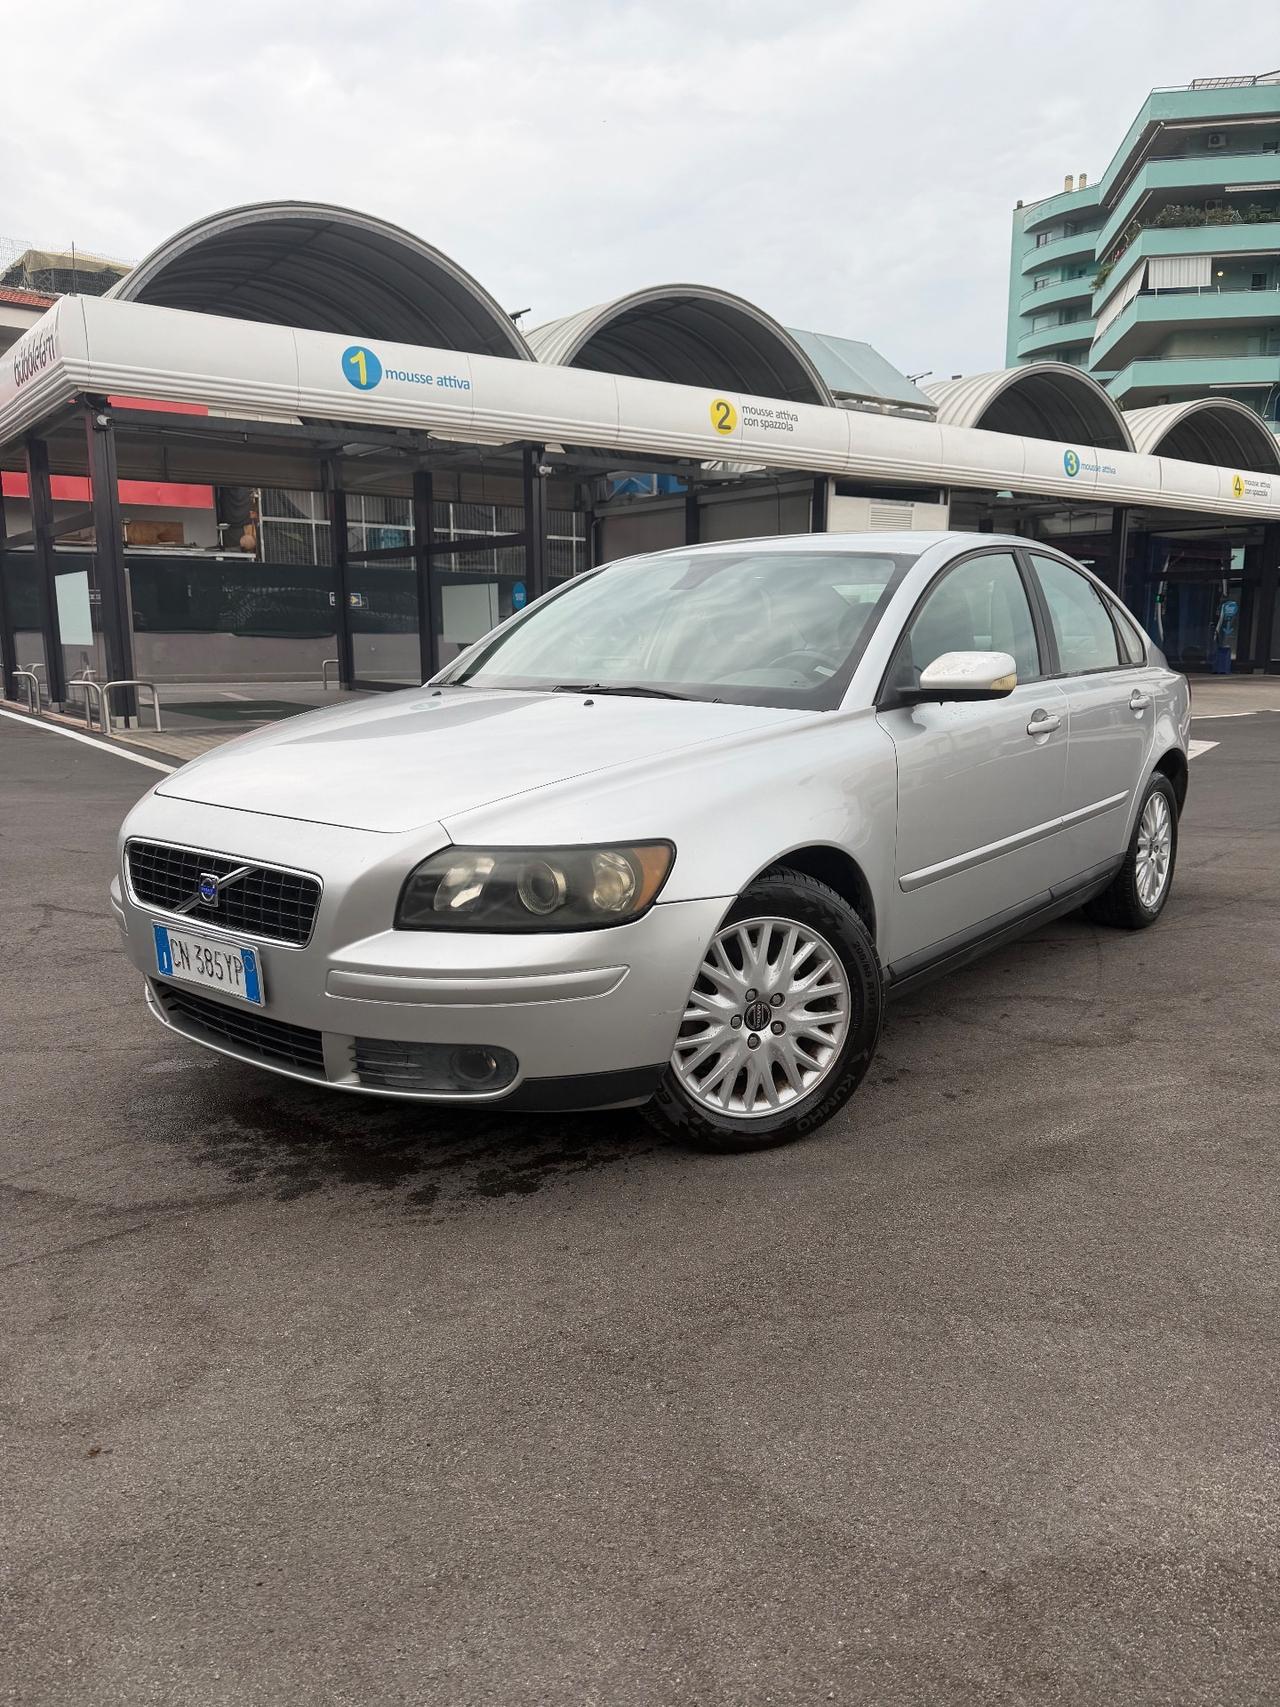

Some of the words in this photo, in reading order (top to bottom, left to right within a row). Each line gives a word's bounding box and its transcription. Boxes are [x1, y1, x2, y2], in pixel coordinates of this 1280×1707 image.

[350, 350, 367, 386] 1
[385, 368, 433, 385] mousse
[436, 375, 471, 390] attiva
[716, 401, 731, 430] 2
[742, 405, 774, 418] mousse
[775, 410, 799, 422] attiva
[743, 416, 759, 428] con
[760, 419, 794, 432] spazzola
[1067, 451, 1077, 474] 3
[1234, 476, 1242, 496] 4
[170, 938, 191, 971] CN
[194, 944, 244, 985] 385YP
[796, 1073, 856, 1131] KUMHO
